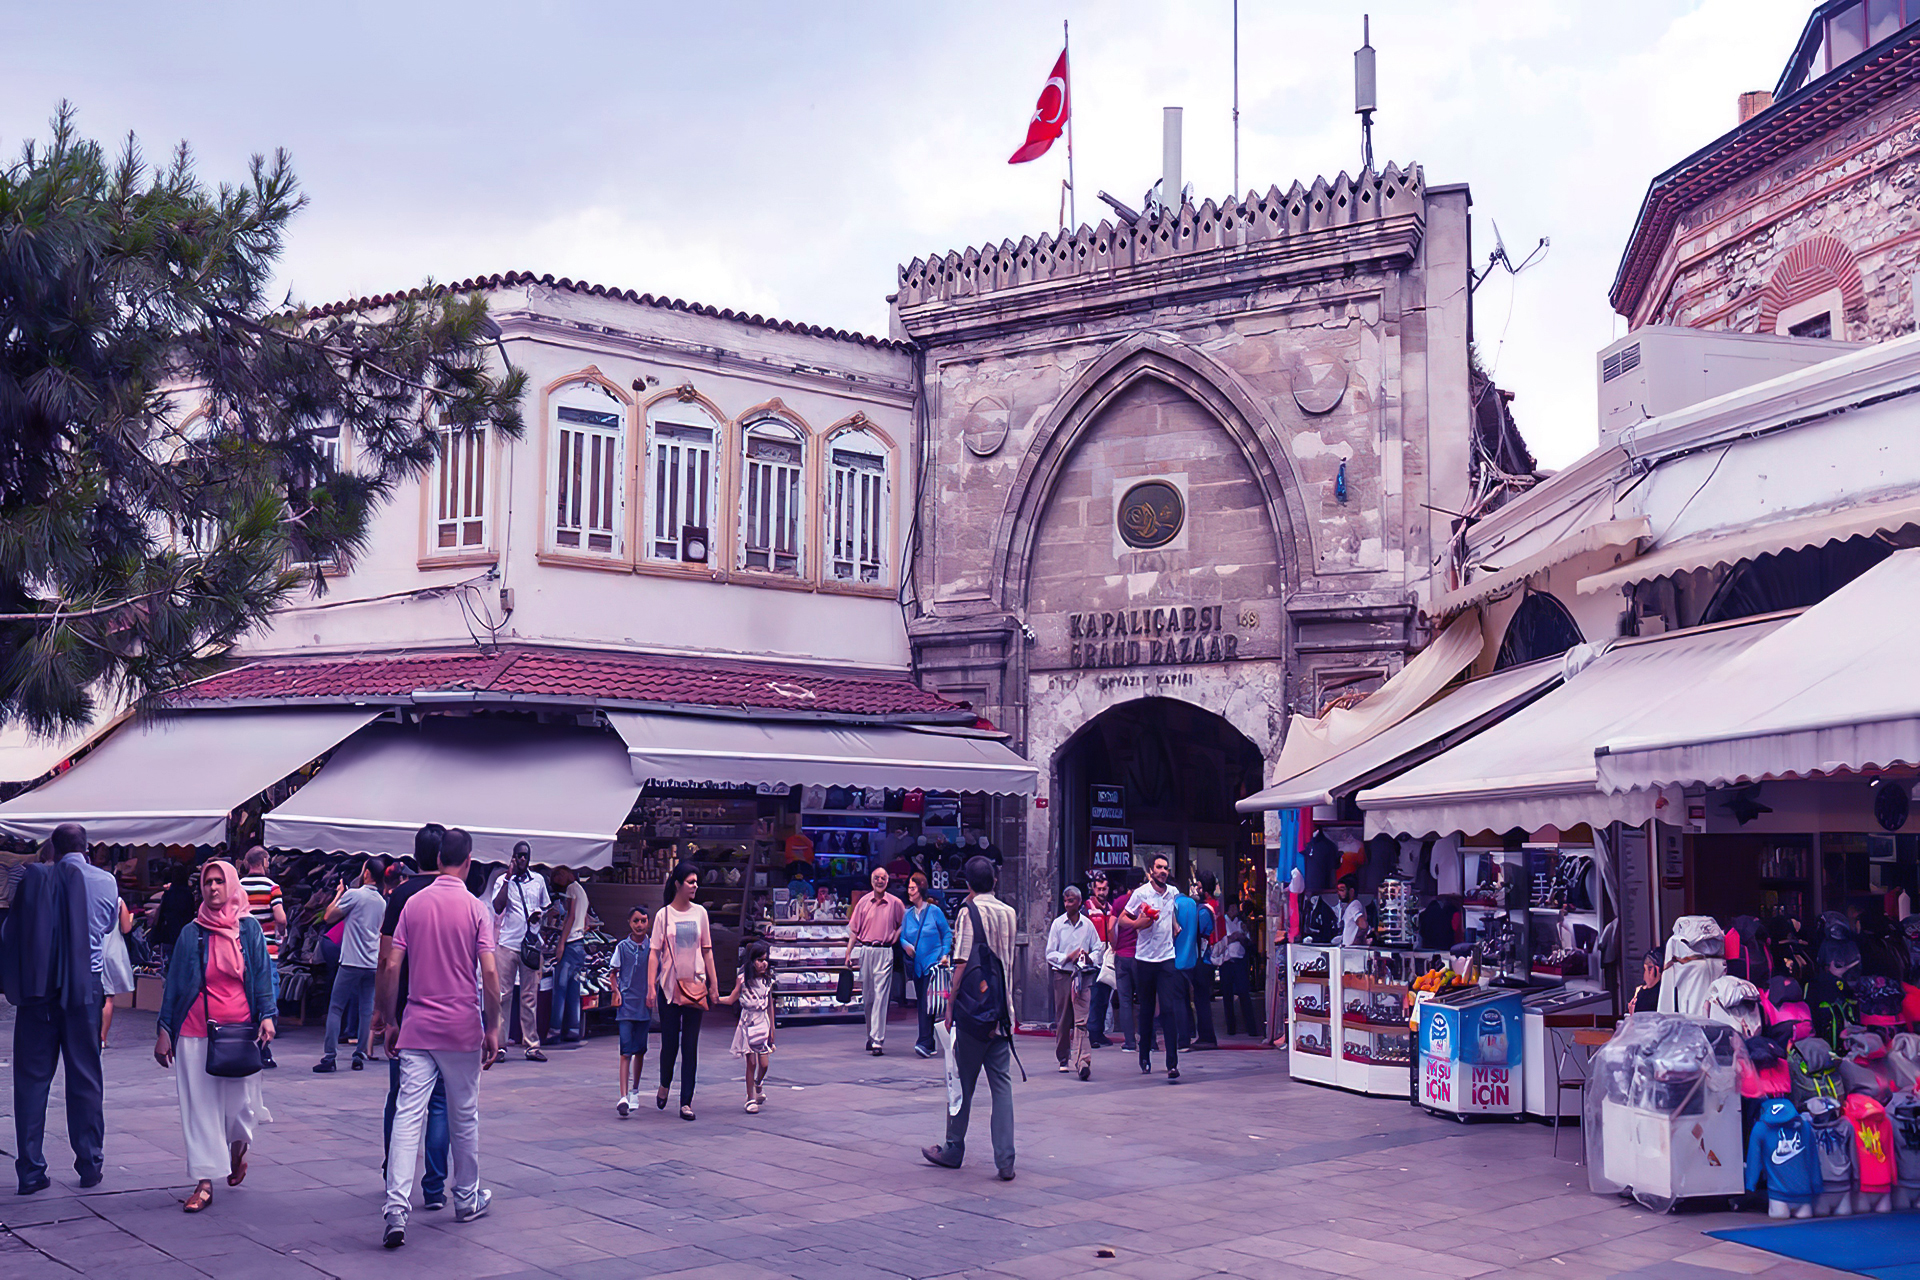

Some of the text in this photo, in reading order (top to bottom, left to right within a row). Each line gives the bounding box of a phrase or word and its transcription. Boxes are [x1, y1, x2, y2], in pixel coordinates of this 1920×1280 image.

[1070, 634, 1239, 668] GRAND BAZAAR
[1096, 834, 1128, 847] ALTIN
[1093, 851, 1130, 865] ALINIR
[1438, 1063, 1451, 1079] SU
[1489, 1068, 1509, 1084] SU
[1472, 1083, 1509, 1109] İÇİN
